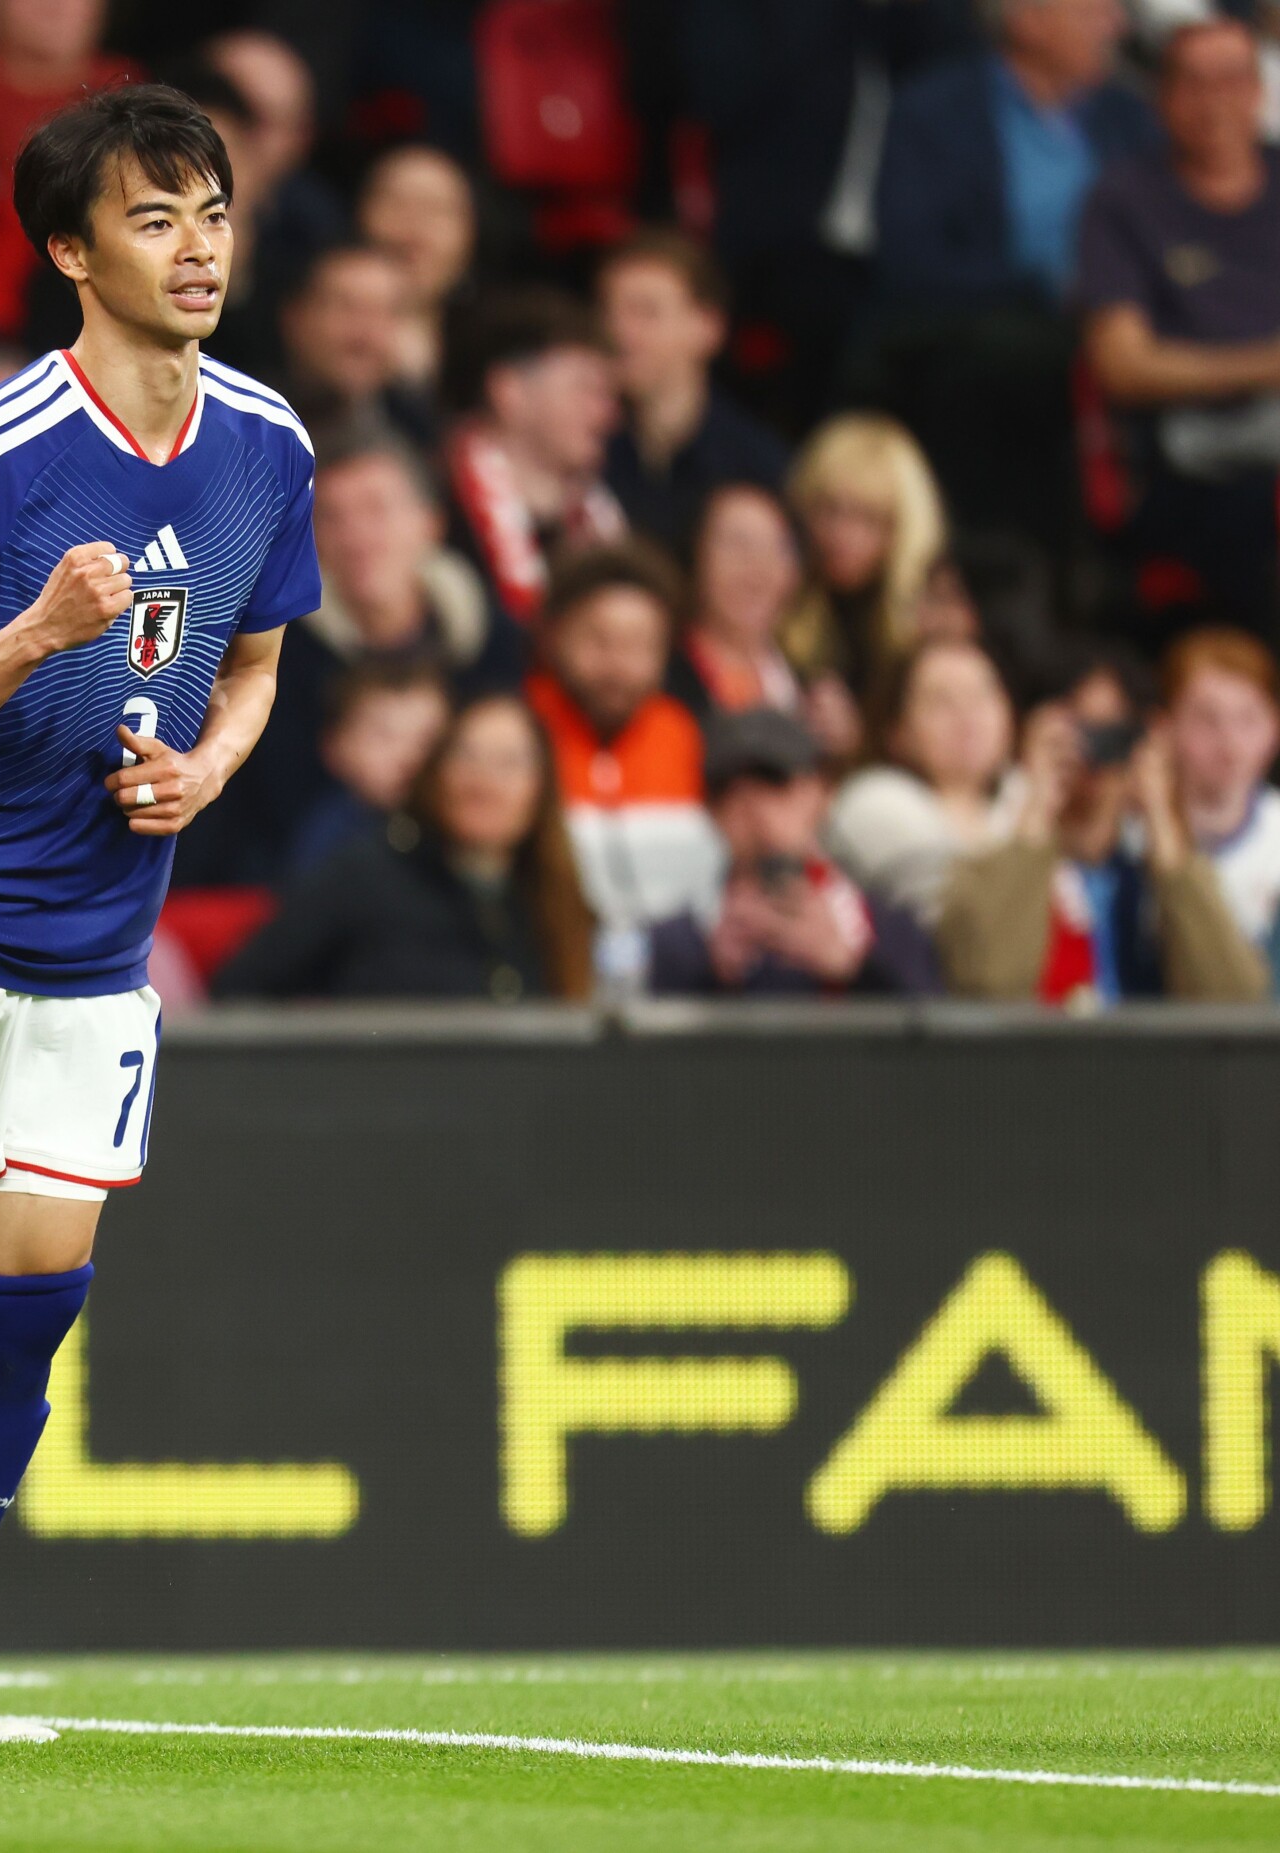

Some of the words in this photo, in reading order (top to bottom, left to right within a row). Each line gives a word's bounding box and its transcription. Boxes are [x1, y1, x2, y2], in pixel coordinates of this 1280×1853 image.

[142, 591, 171, 600] JAPAN
[137, 647, 160, 663] JFA
[113, 1050, 145, 1148] 7
